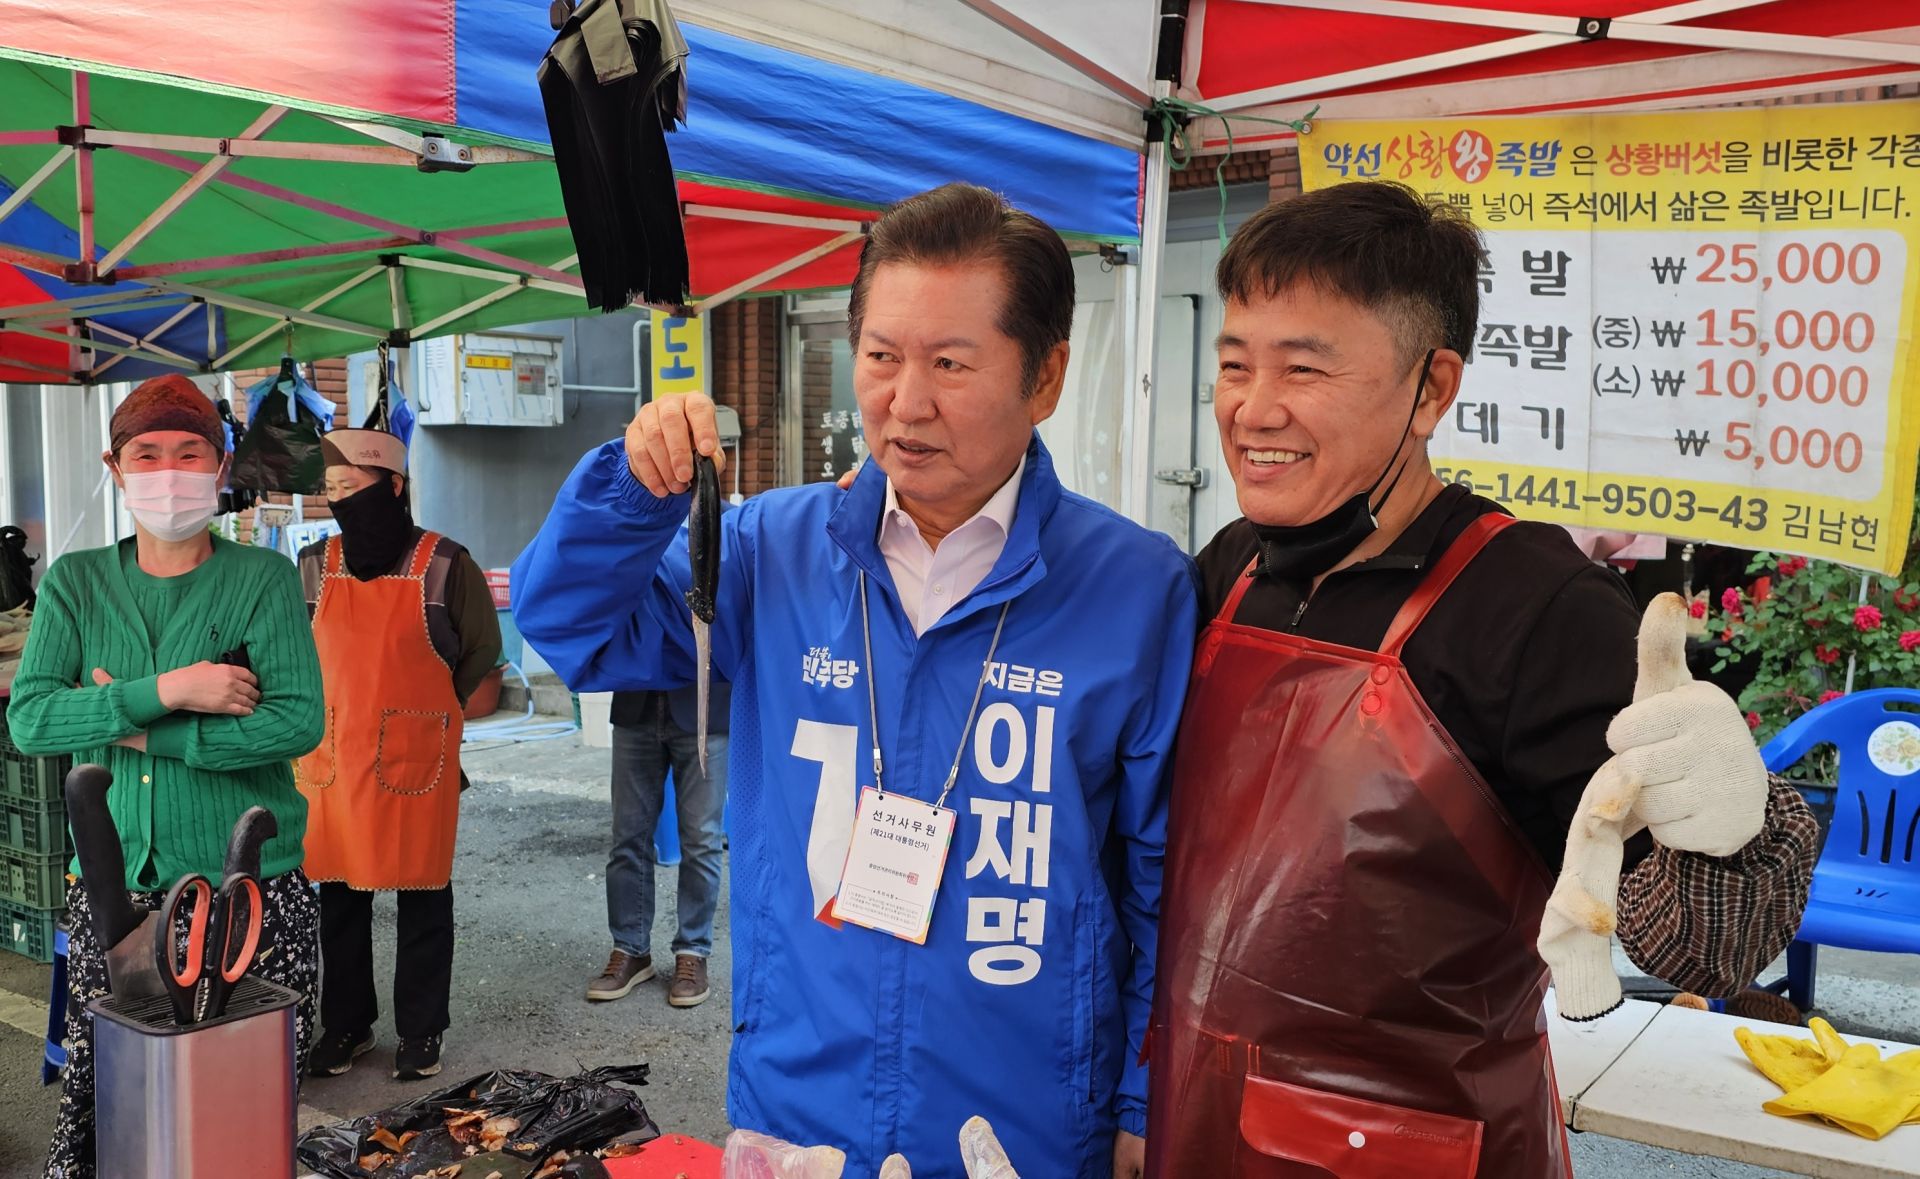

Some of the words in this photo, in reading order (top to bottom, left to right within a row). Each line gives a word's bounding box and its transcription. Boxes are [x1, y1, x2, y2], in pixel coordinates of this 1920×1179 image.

[1569, 145, 1598, 176] 은
[1605, 141, 1752, 176] 상황버섯을
[1763, 136, 1857, 172] 비롯한
[1482, 193, 1534, 222] 넣어
[1543, 191, 1657, 222] 즉석에서
[1667, 190, 1730, 222] 삶은
[1738, 186, 1911, 222] 족발입니다.
[1696, 242, 1881, 292] 25,000
[1592, 315, 1641, 351] (중)
[1696, 309, 1875, 357] 15,000
[1592, 363, 1641, 399] (소)
[1695, 358, 1869, 408] 10,000
[1724, 422, 1863, 473] 5,000
[1782, 504, 1879, 552] 김남현
[802, 654, 860, 689] 민주당
[979, 660, 1063, 696] 지금은
[790, 718, 859, 921] 1
[872, 809, 937, 837] 선거사무원
